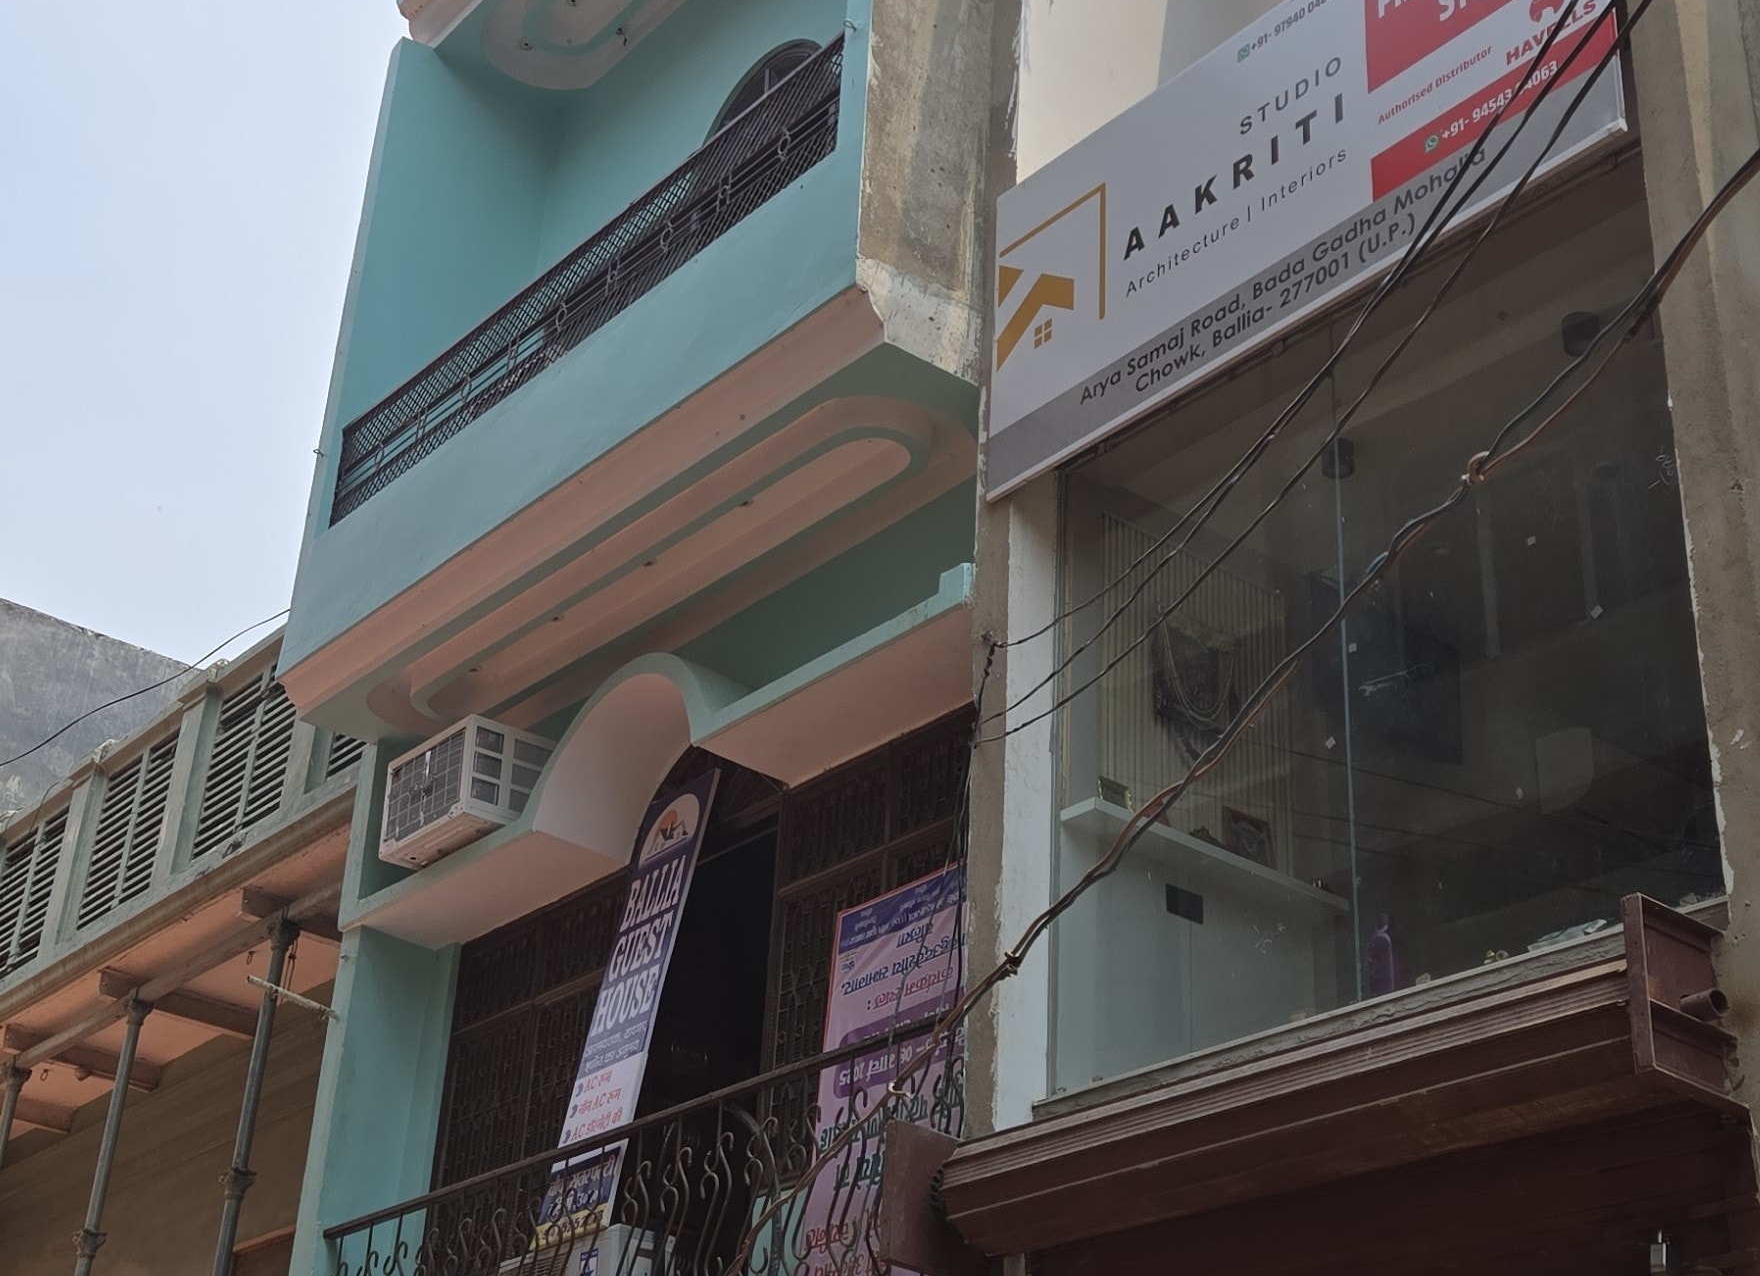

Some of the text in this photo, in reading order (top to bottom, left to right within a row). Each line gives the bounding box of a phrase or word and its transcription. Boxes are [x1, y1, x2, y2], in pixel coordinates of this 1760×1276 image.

[1274, 7, 1305, 36] 97940
[1239, 56, 1342, 135] STUDIO
[1378, 45, 1493, 125] Authorised Distributor
[1472, 87, 1513, 122] 94543
[1123, 92, 1345, 262] AAKRITI
[1126, 217, 1240, 297] Architecture
[1261, 149, 1347, 211] Interiors
[1080, 370, 1122, 406] Arya
[1127, 330, 1185, 376] Samaj
[1191, 293, 1247, 338] Road,
[1253, 257, 1306, 301] Bada
[1312, 208, 1387, 262] Gadha
[1135, 212, 1416, 393] Chowk, Ballia- 277001 (U.P.)
[619, 855, 687, 933] BALLIA
[608, 910, 675, 983] GUEST
[591, 964, 661, 1039] HOUSE
